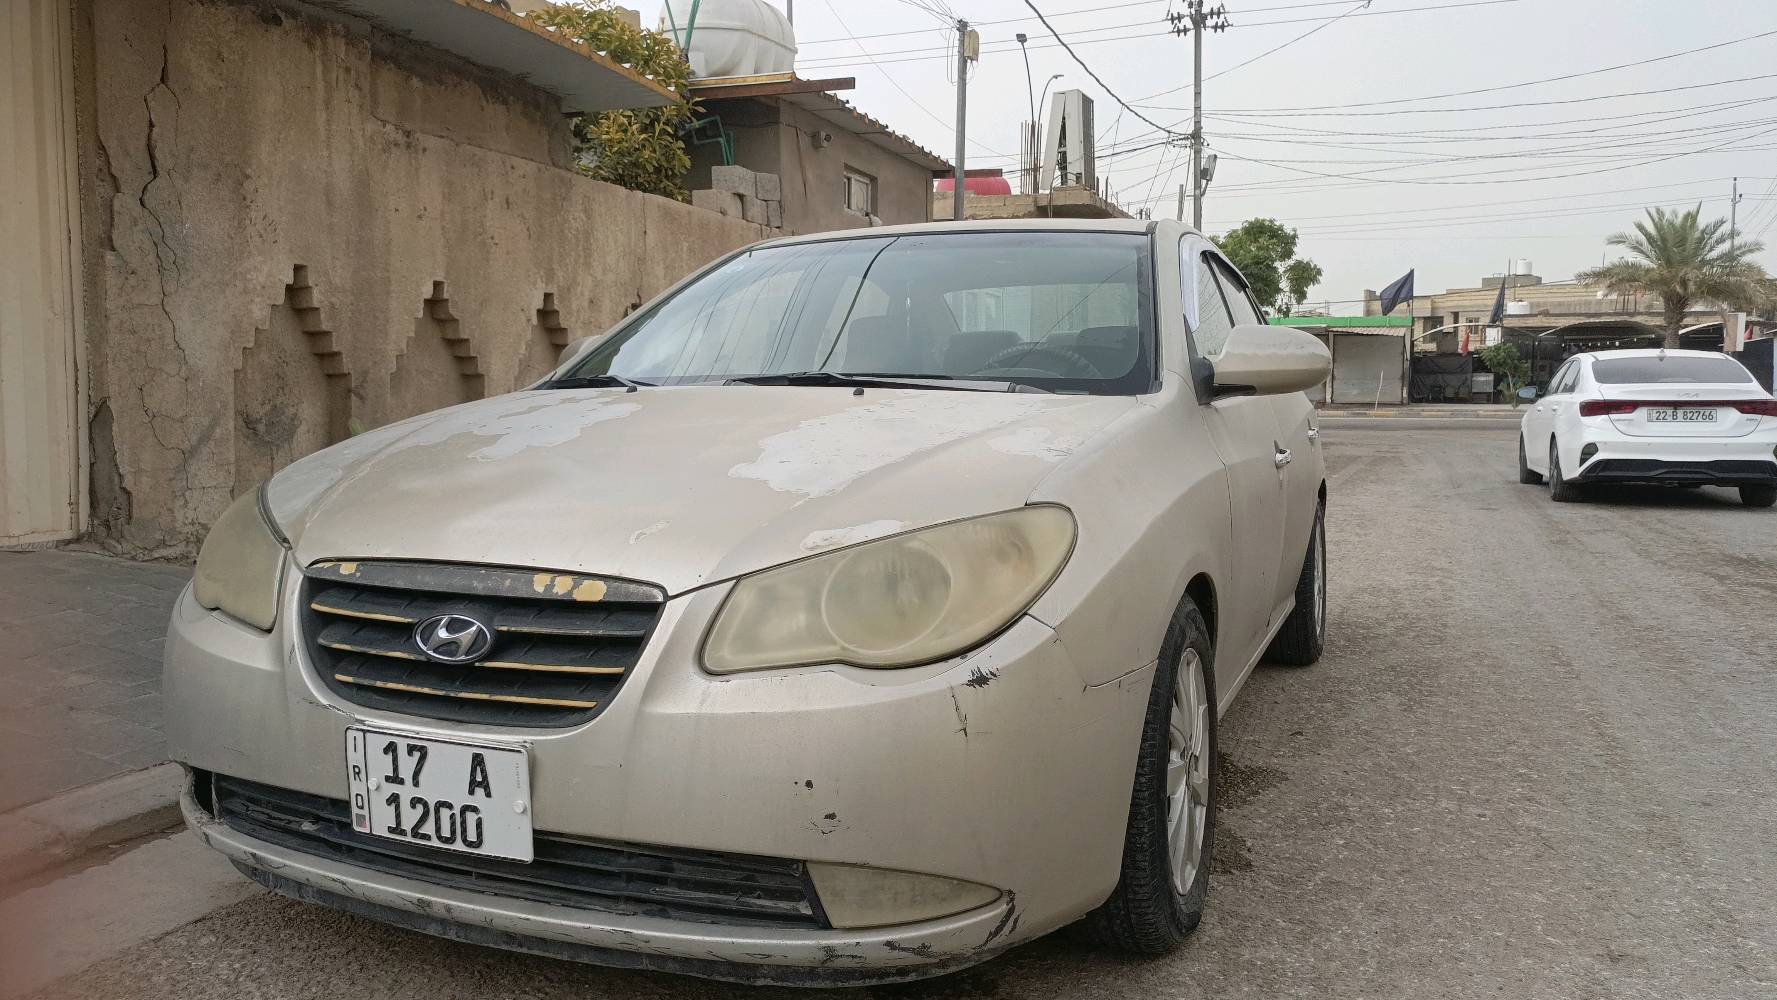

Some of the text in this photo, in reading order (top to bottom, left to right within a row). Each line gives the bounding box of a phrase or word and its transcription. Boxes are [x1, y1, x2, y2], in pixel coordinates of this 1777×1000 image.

[1655, 410, 1668, 421] 22
[1671, 410, 1679, 421] B
[1682, 410, 1714, 421] 82766
[382, 740, 428, 788] 17
[467, 752, 492, 798] A
[385, 792, 484, 849] 1200
